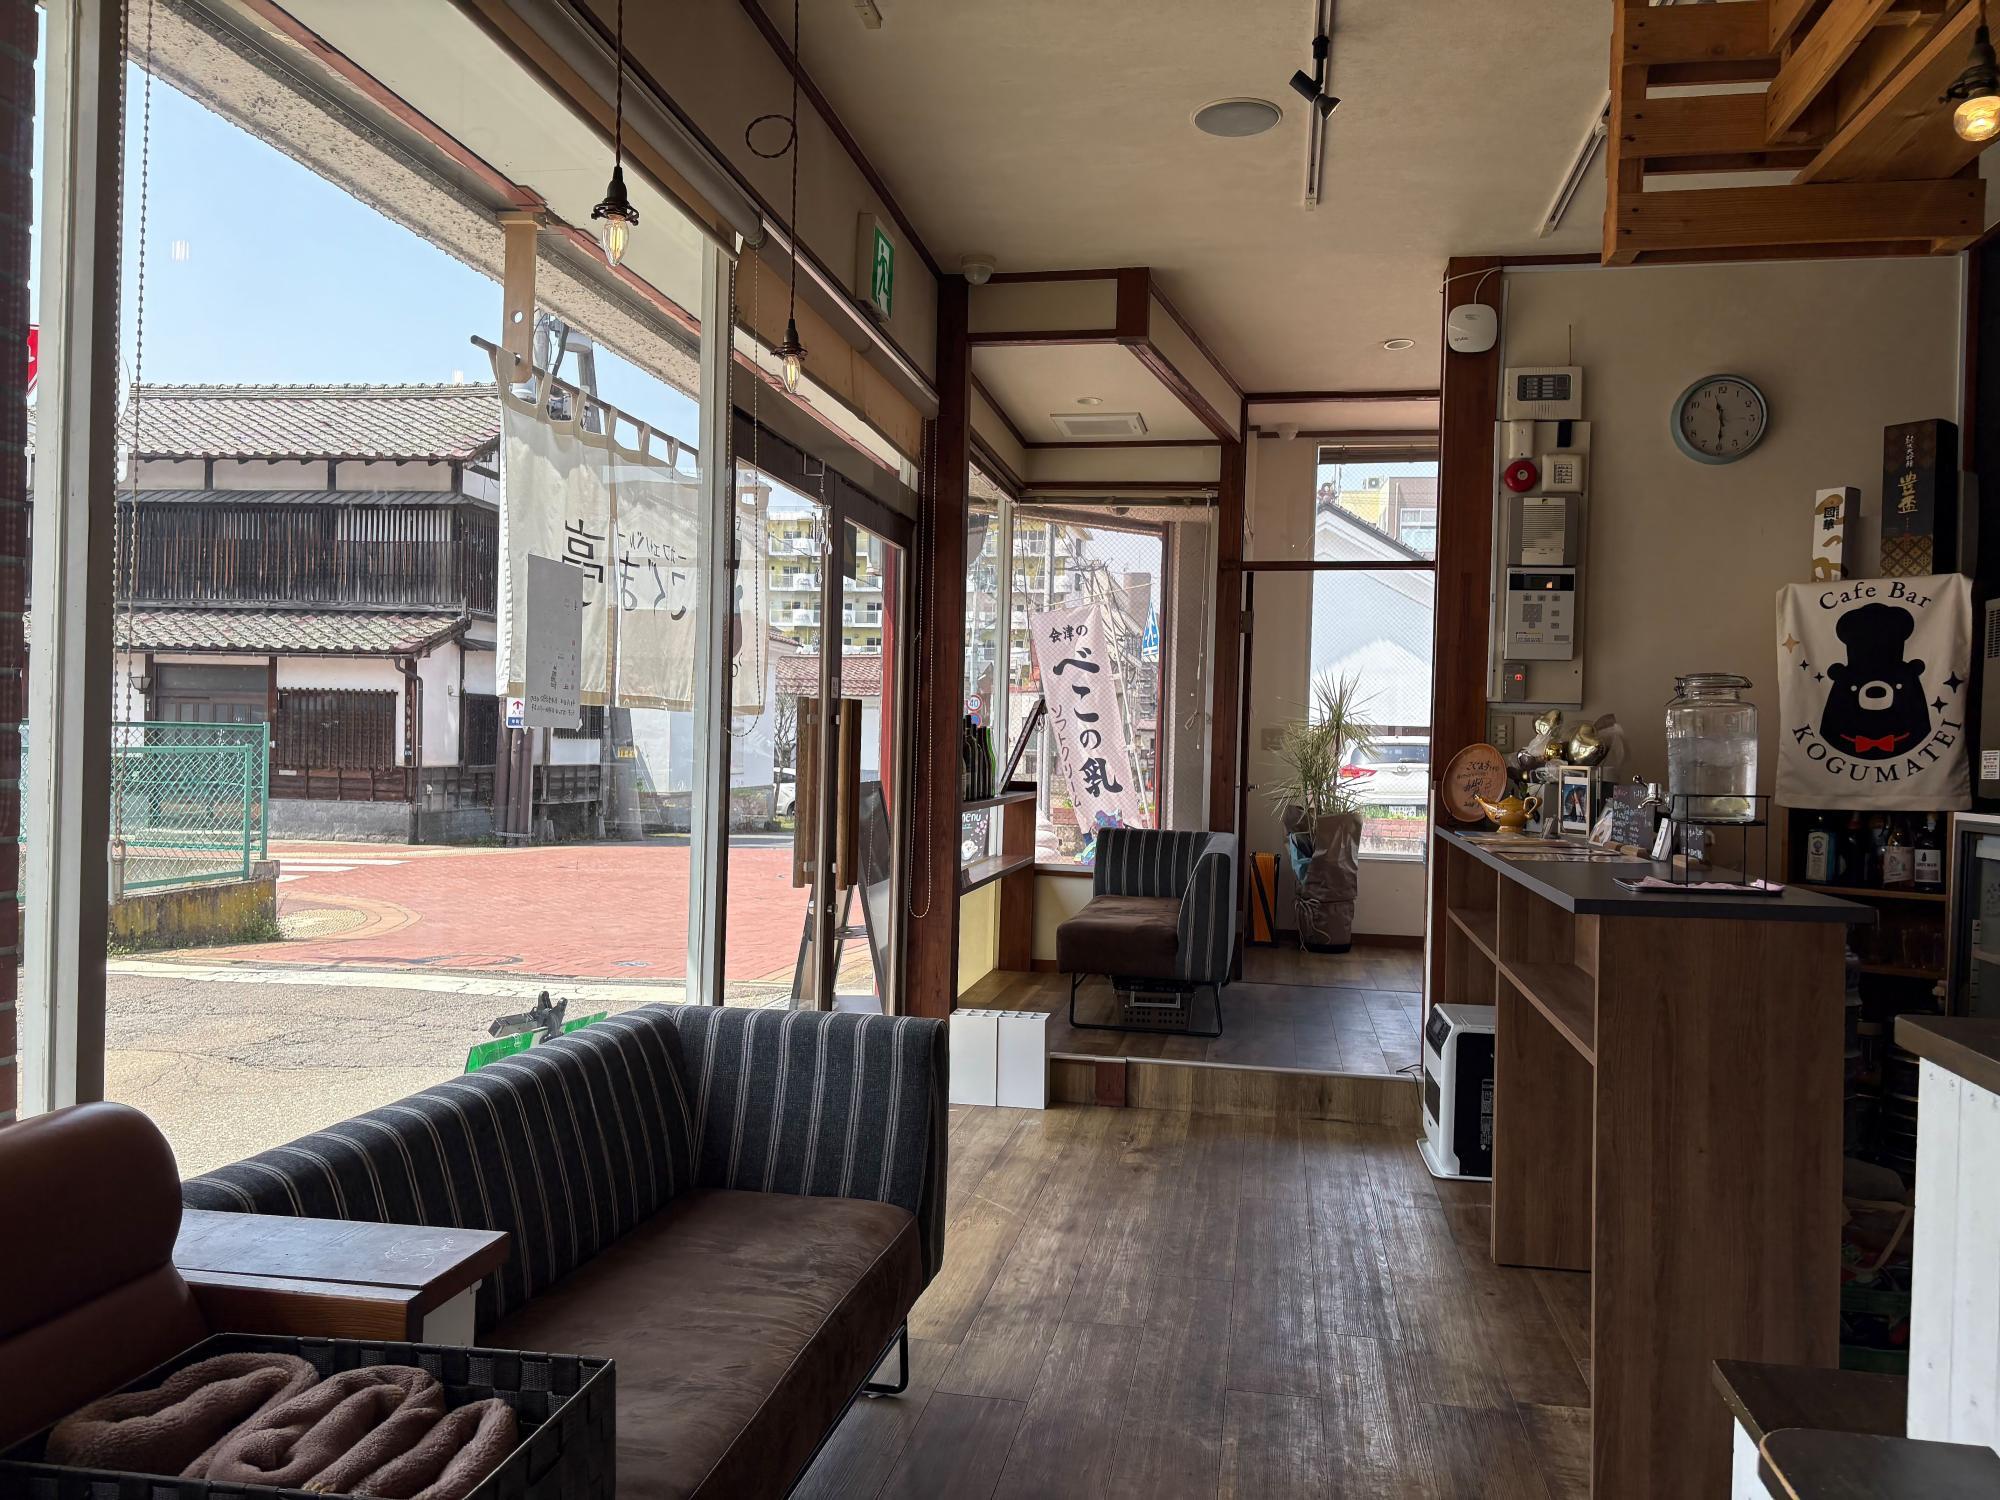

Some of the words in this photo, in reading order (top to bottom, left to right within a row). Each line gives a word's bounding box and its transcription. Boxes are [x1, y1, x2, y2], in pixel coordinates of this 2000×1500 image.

[1819, 581, 1877, 610] Cafe
[1888, 581, 1933, 609] Bar
[1049, 624, 1088, 644] 会津の
[969, 699, 979, 708] 40
[1052, 646, 1123, 798] べこの乳
[1051, 704, 1081, 807] ソフトクリーム
[1792, 718, 1962, 783] KOGUMATEI
